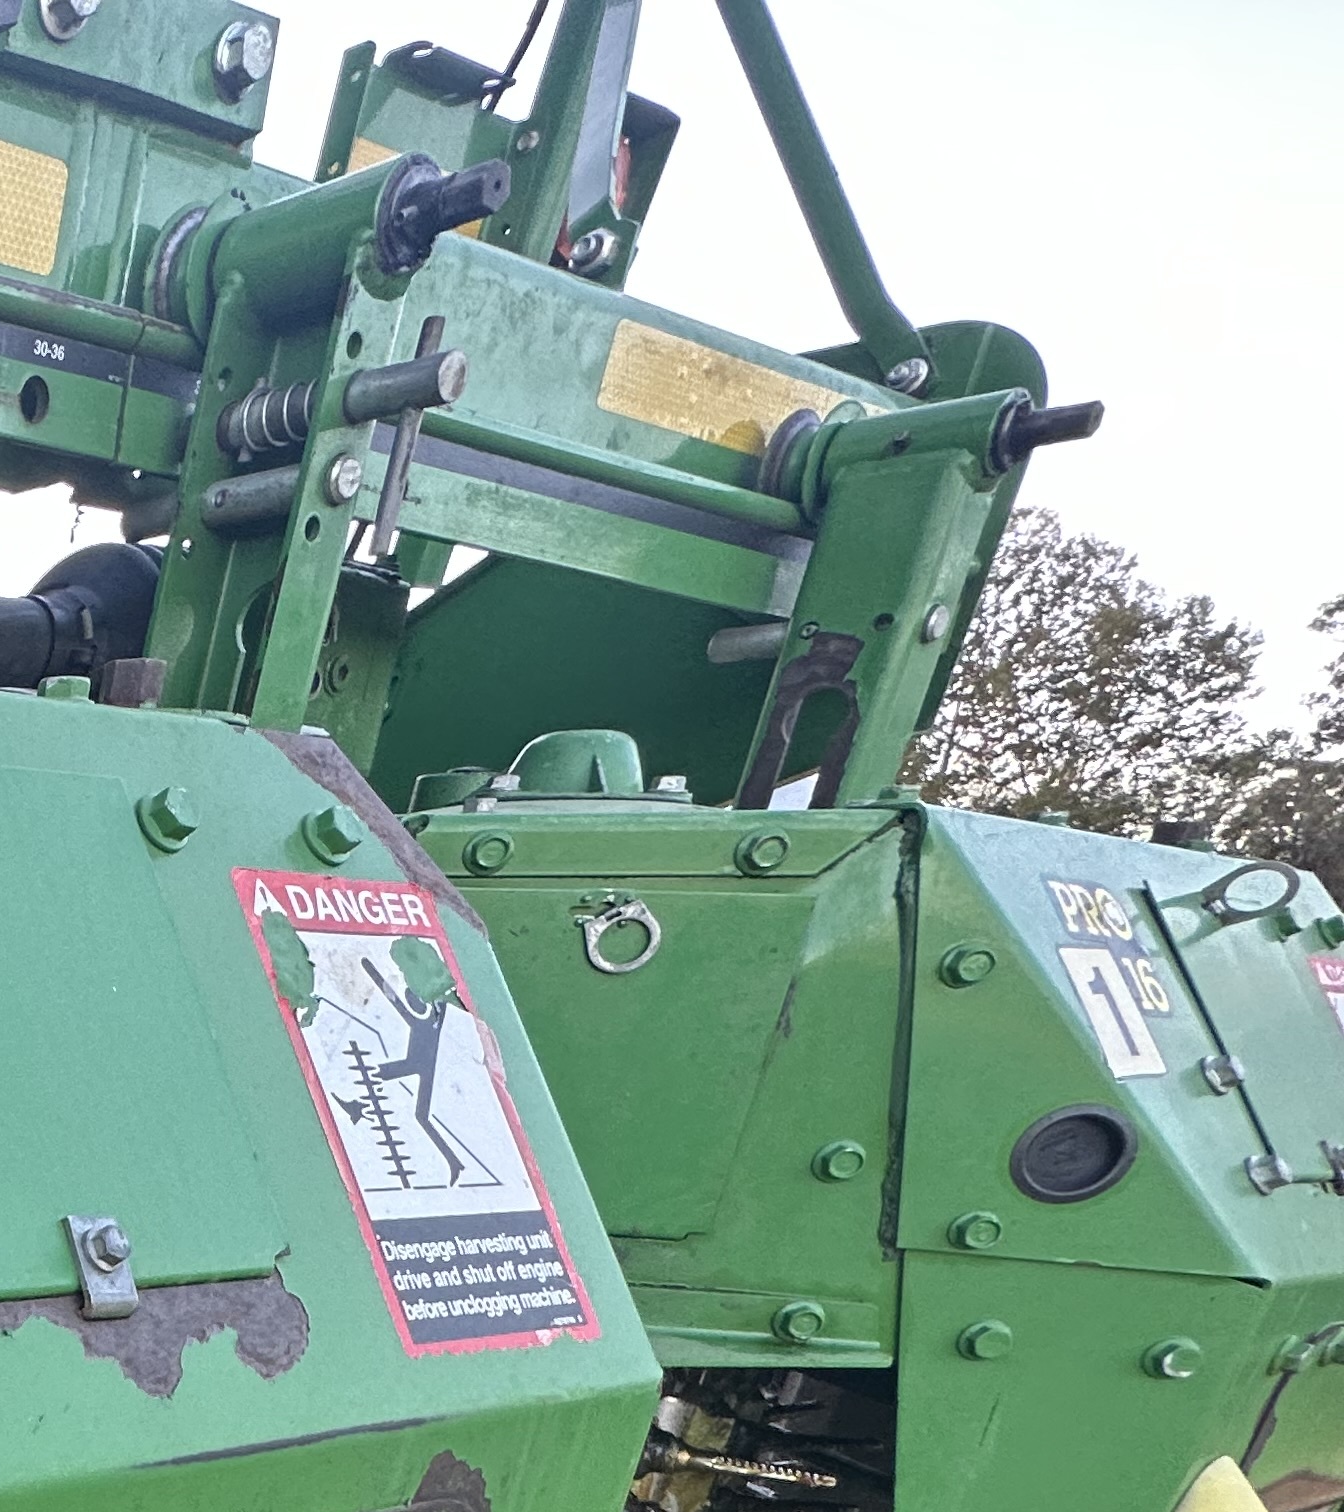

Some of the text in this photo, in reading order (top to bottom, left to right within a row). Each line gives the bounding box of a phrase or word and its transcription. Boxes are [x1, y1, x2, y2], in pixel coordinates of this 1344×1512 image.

[33, 339, 65, 361] 30-36
[284, 884, 432, 928] DANGER
[1049, 880, 1134, 941] PRO
[1123, 956, 1171, 1013] 16
[1087, 964, 1141, 1057] 1
[380, 1230, 553, 1263] Disengage harvesting unit
[393, 1258, 564, 1291] drive and shut off engine
[401, 1286, 577, 1321] before unclogging machine.
